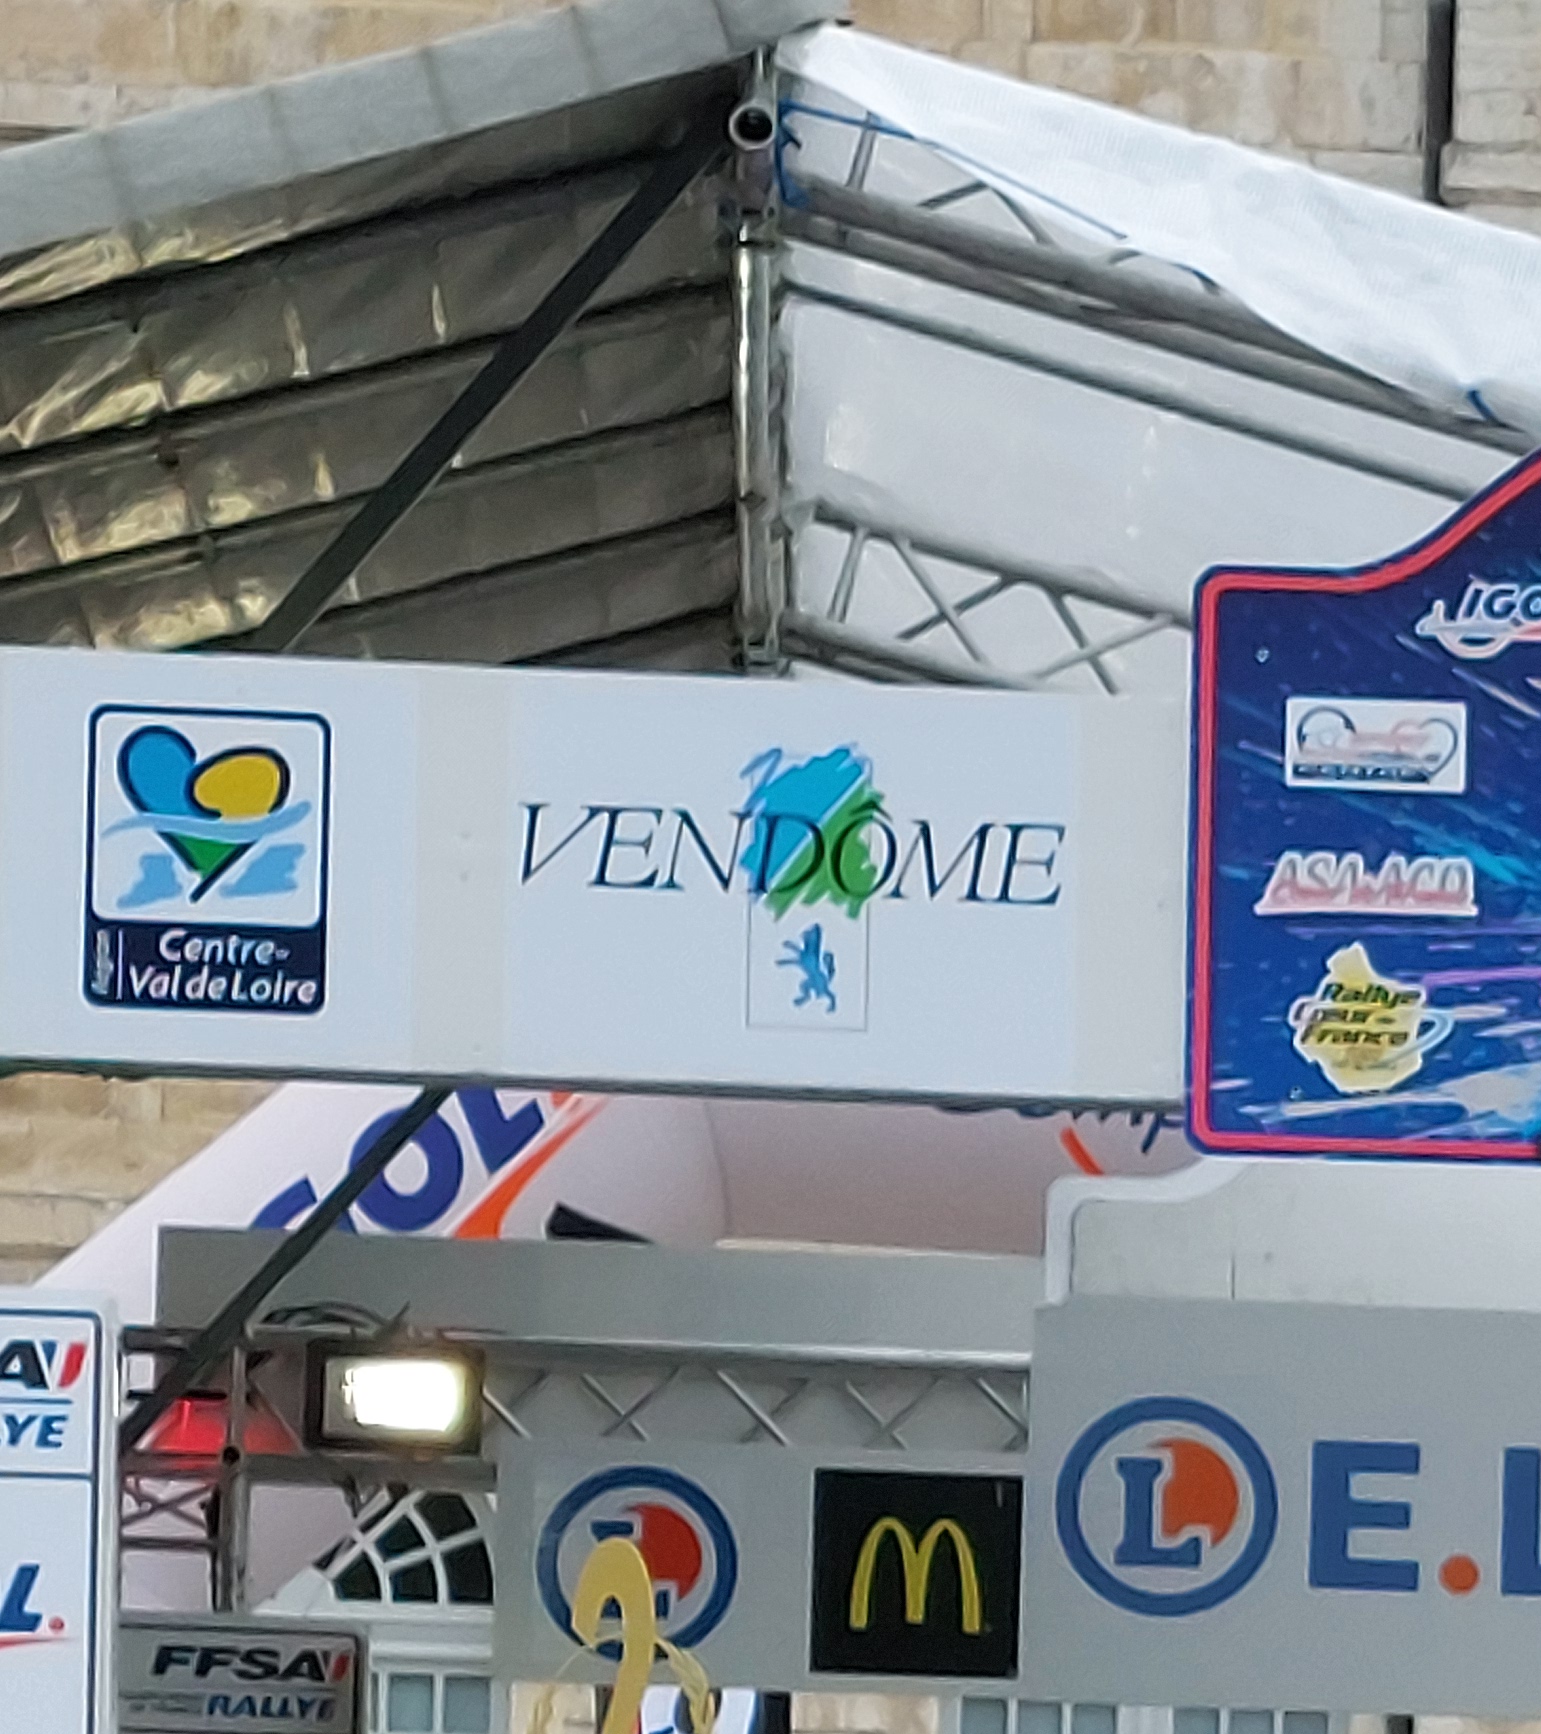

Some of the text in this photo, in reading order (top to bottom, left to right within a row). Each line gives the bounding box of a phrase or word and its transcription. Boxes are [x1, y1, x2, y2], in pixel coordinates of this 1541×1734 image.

[517, 794, 1068, 908] VENDÔME
[158, 926, 291, 965] Centre-
[129, 963, 318, 1005] Val de Loire
[152, 1645, 329, 1682] FFSA
[206, 1695, 338, 1723] RALLYE
